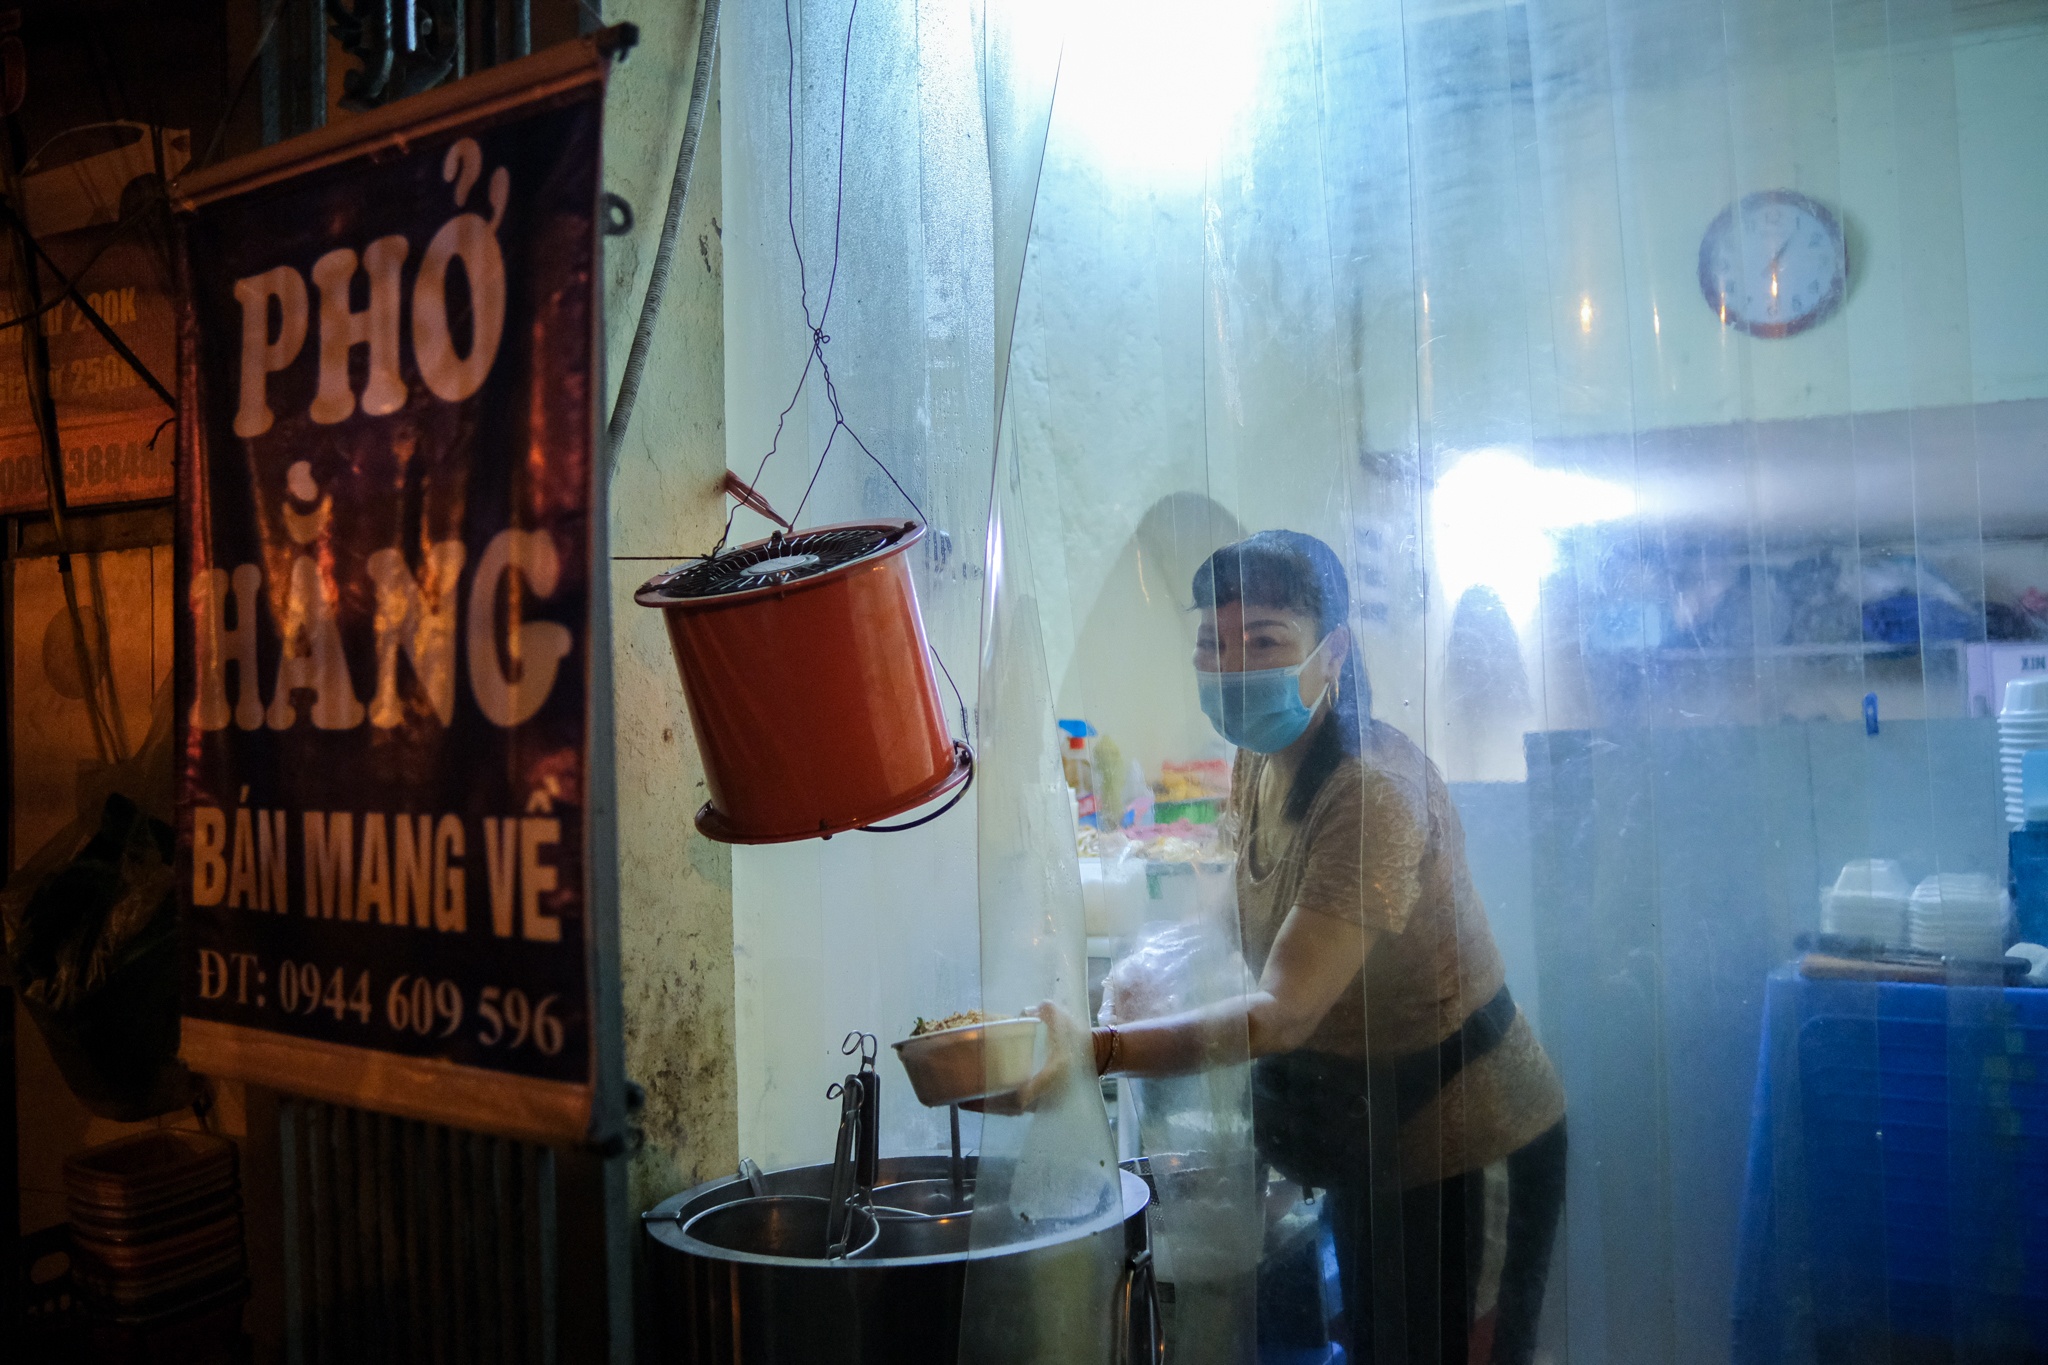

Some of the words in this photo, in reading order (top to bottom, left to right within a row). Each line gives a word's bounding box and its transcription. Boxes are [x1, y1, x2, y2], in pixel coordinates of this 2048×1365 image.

[232, 137, 510, 438] PHỞ
[193, 784, 288, 915] BÁN
[303, 811, 467, 934] MANG
[483, 775, 562, 943] VỀ
[198, 949, 267, 1008] ĐT:
[279, 959, 372, 1024] 0944
[386, 974, 463, 1039] 609
[478, 985, 565, 1056] 596
